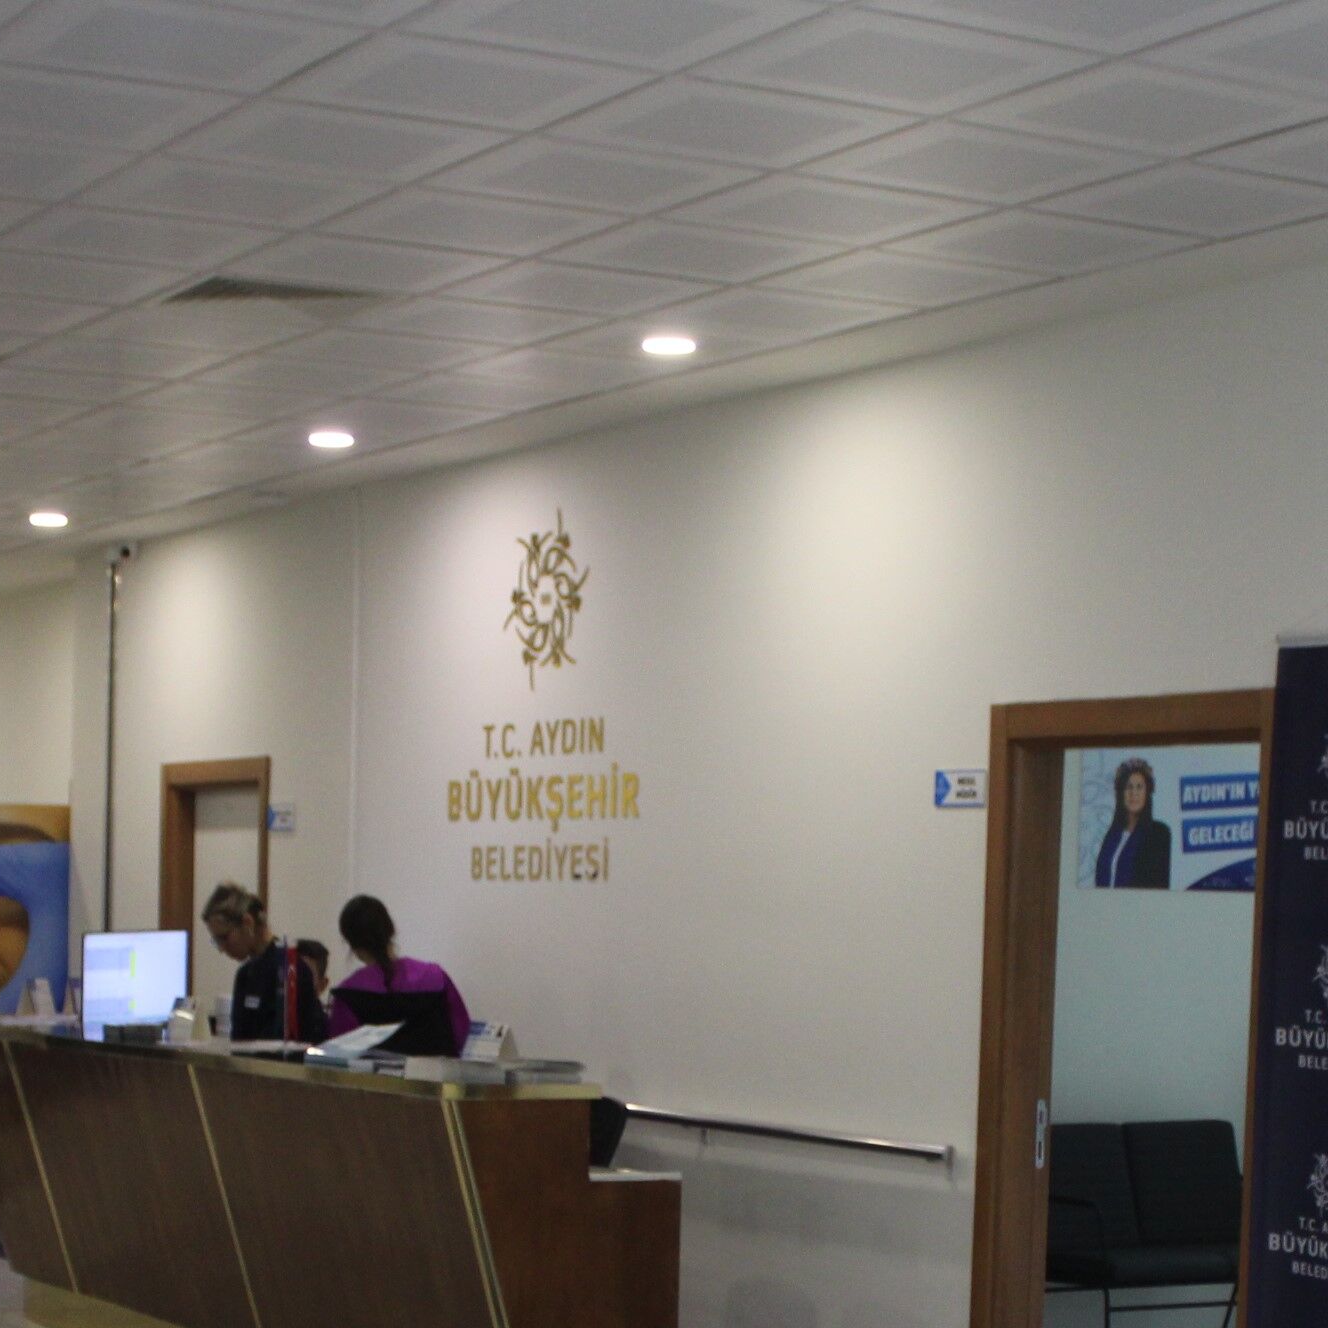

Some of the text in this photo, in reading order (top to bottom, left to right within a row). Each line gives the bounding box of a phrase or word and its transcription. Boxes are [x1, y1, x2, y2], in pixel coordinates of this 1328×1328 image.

[483, 717, 605, 758] T.C. AYDIN
[448, 762, 640, 833] BÜYÜKŞEHİR
[472, 837, 610, 881] BELEDİYESİ
